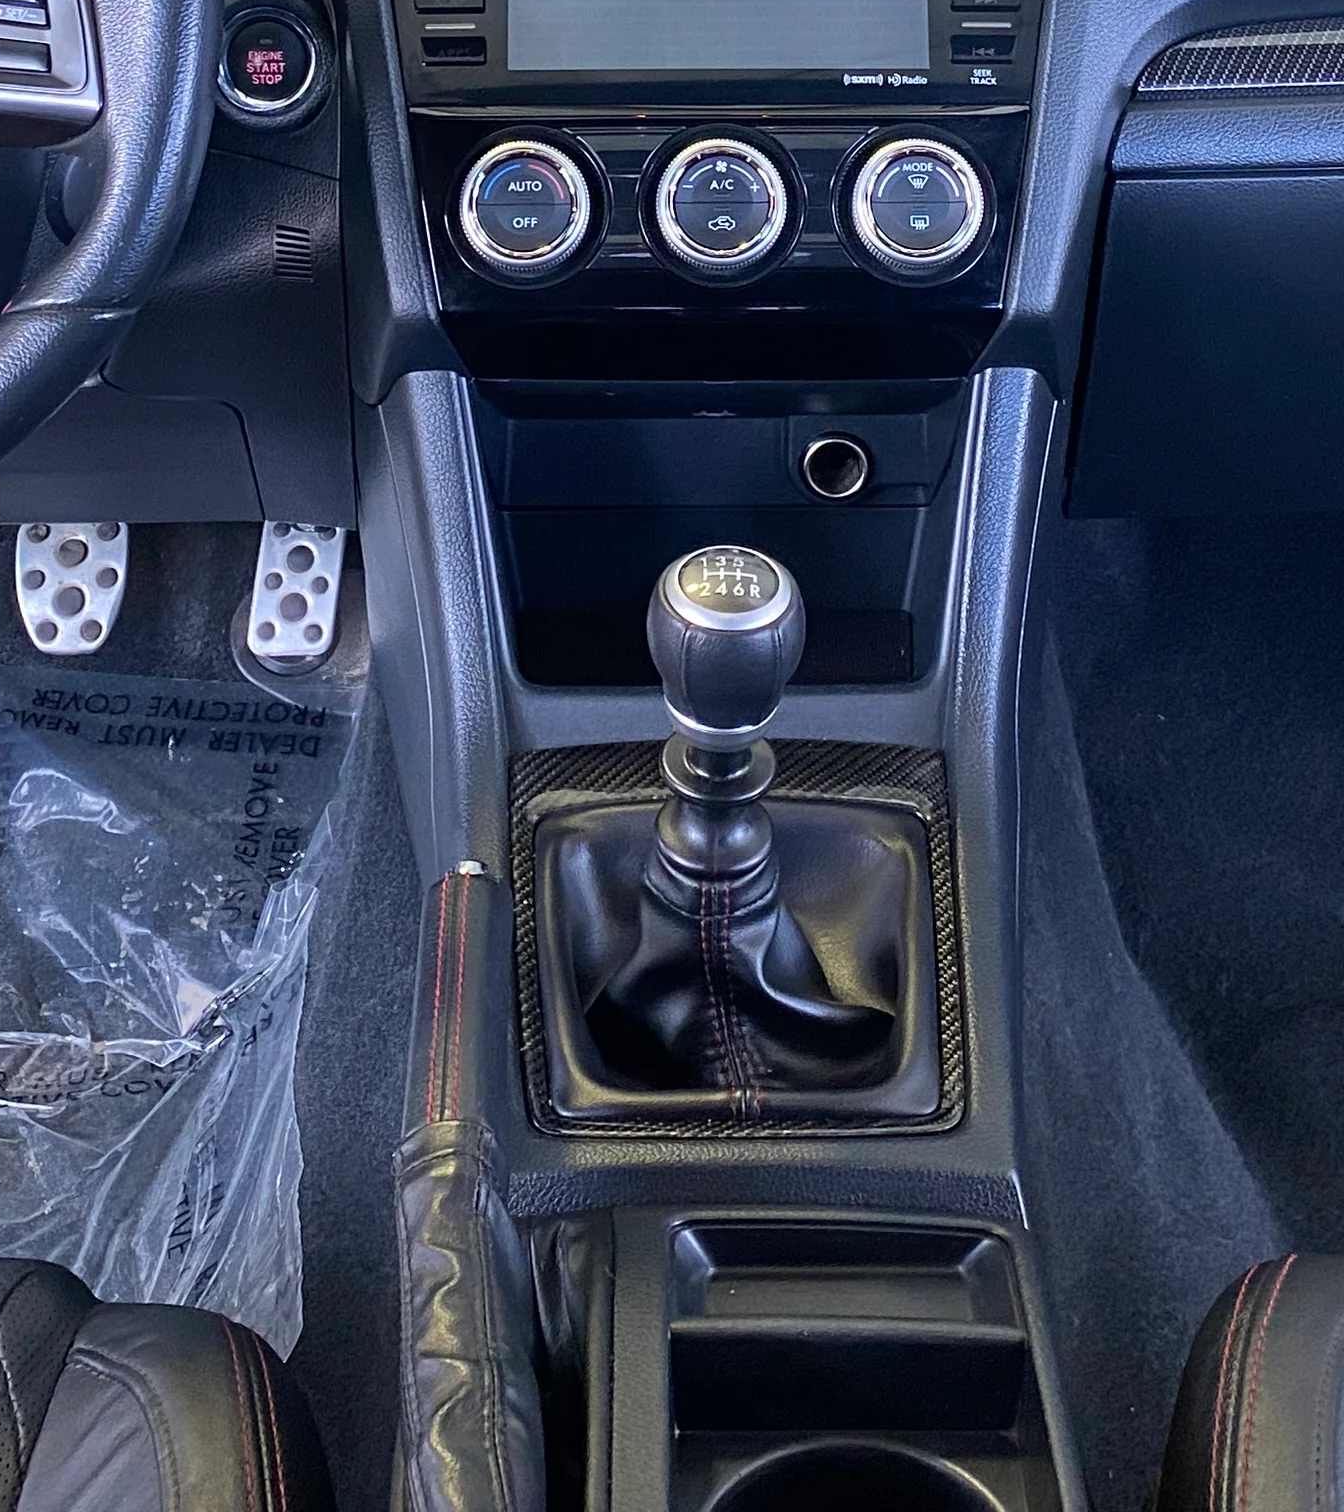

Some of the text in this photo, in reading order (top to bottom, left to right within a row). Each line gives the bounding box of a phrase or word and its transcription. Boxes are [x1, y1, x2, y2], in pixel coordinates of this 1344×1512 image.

[248, 51, 284, 61] ENGINE
[246, 62, 286, 73] START
[972, 69, 993, 77] SEEK
[251, 74, 283, 85] STOP
[902, 75, 928, 85] Radio
[969, 76, 998, 86] TRACK
[902, 162, 934, 173] MODE
[507, 180, 543, 192] AUTO
[709, 178, 735, 192] A/C
[512, 216, 538, 230] OFF
[700, 556, 745, 568] 1 3 5
[699, 582, 761, 598] 2 4 6 R
[31, 687, 327, 728] PROTECTIVE COVER
[97, 723, 187, 748] MUST
[207, 729, 323, 758] DEALER
[233, 761, 279, 870] REMOVE
